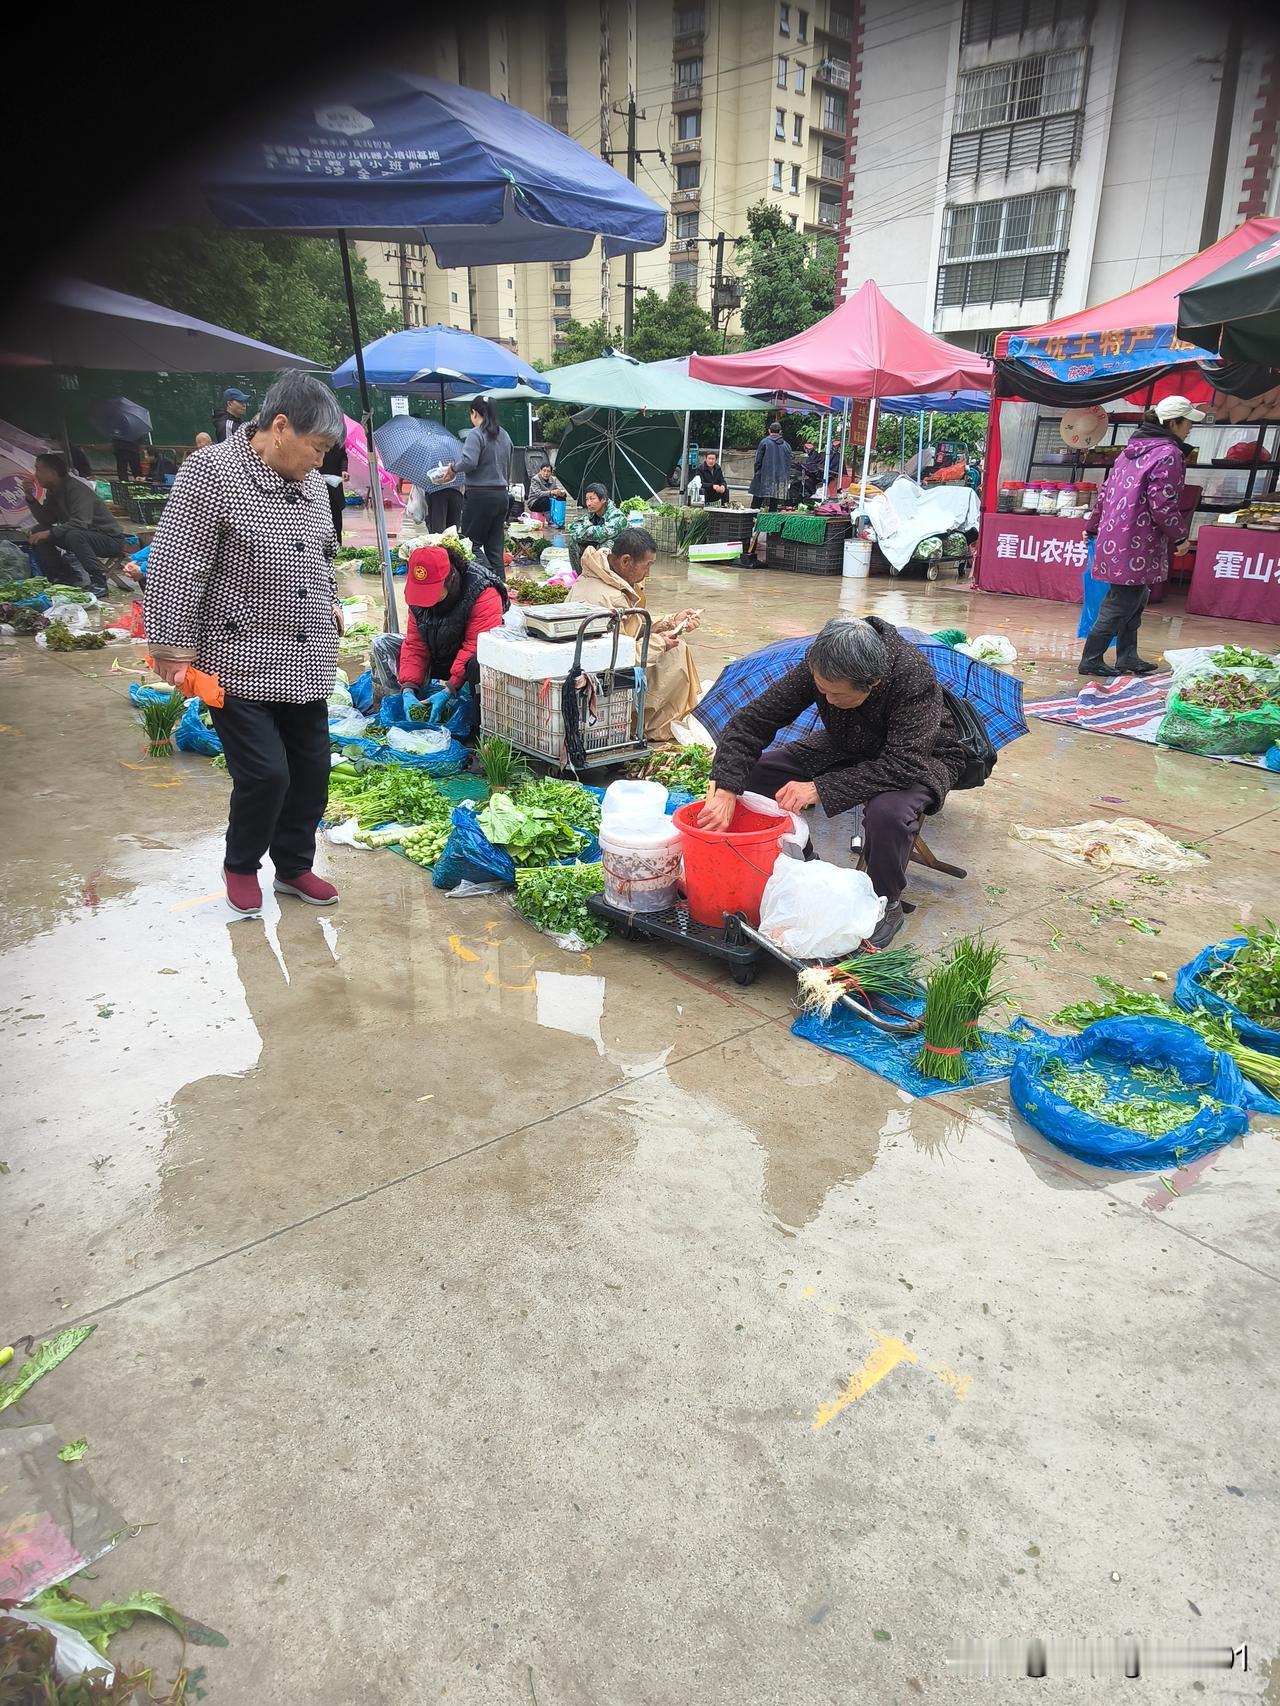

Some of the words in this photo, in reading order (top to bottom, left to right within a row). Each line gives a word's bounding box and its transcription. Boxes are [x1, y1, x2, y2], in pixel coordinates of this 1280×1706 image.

[1028, 326, 1155, 361] 优土特产
[997, 533, 1088, 567] 霍山农特
[1213, 551, 1280, 583] 霍山
